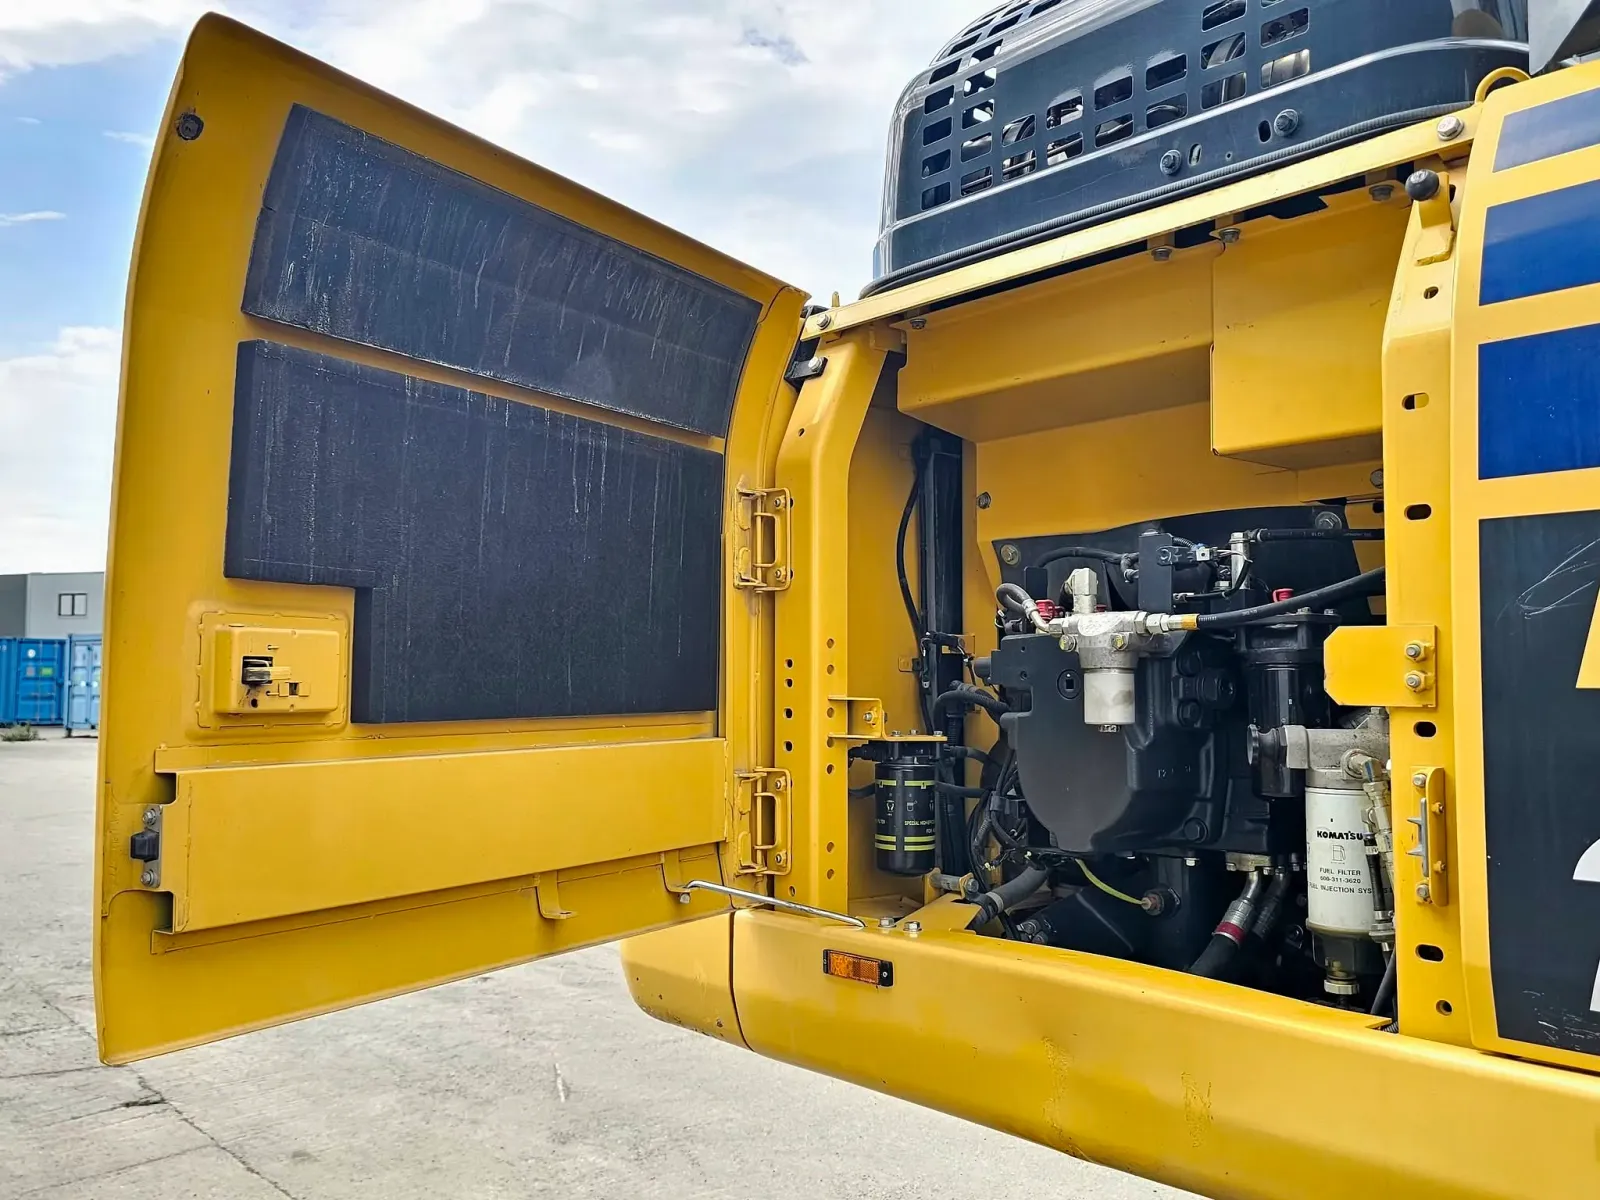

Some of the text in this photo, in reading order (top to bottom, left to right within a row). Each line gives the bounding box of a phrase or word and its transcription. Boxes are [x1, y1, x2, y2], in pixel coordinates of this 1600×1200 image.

[1317, 830, 1364, 841] KOMATSU
[1319, 867, 1335, 875] FUEL
[1320, 885, 1355, 894] INJECTION
